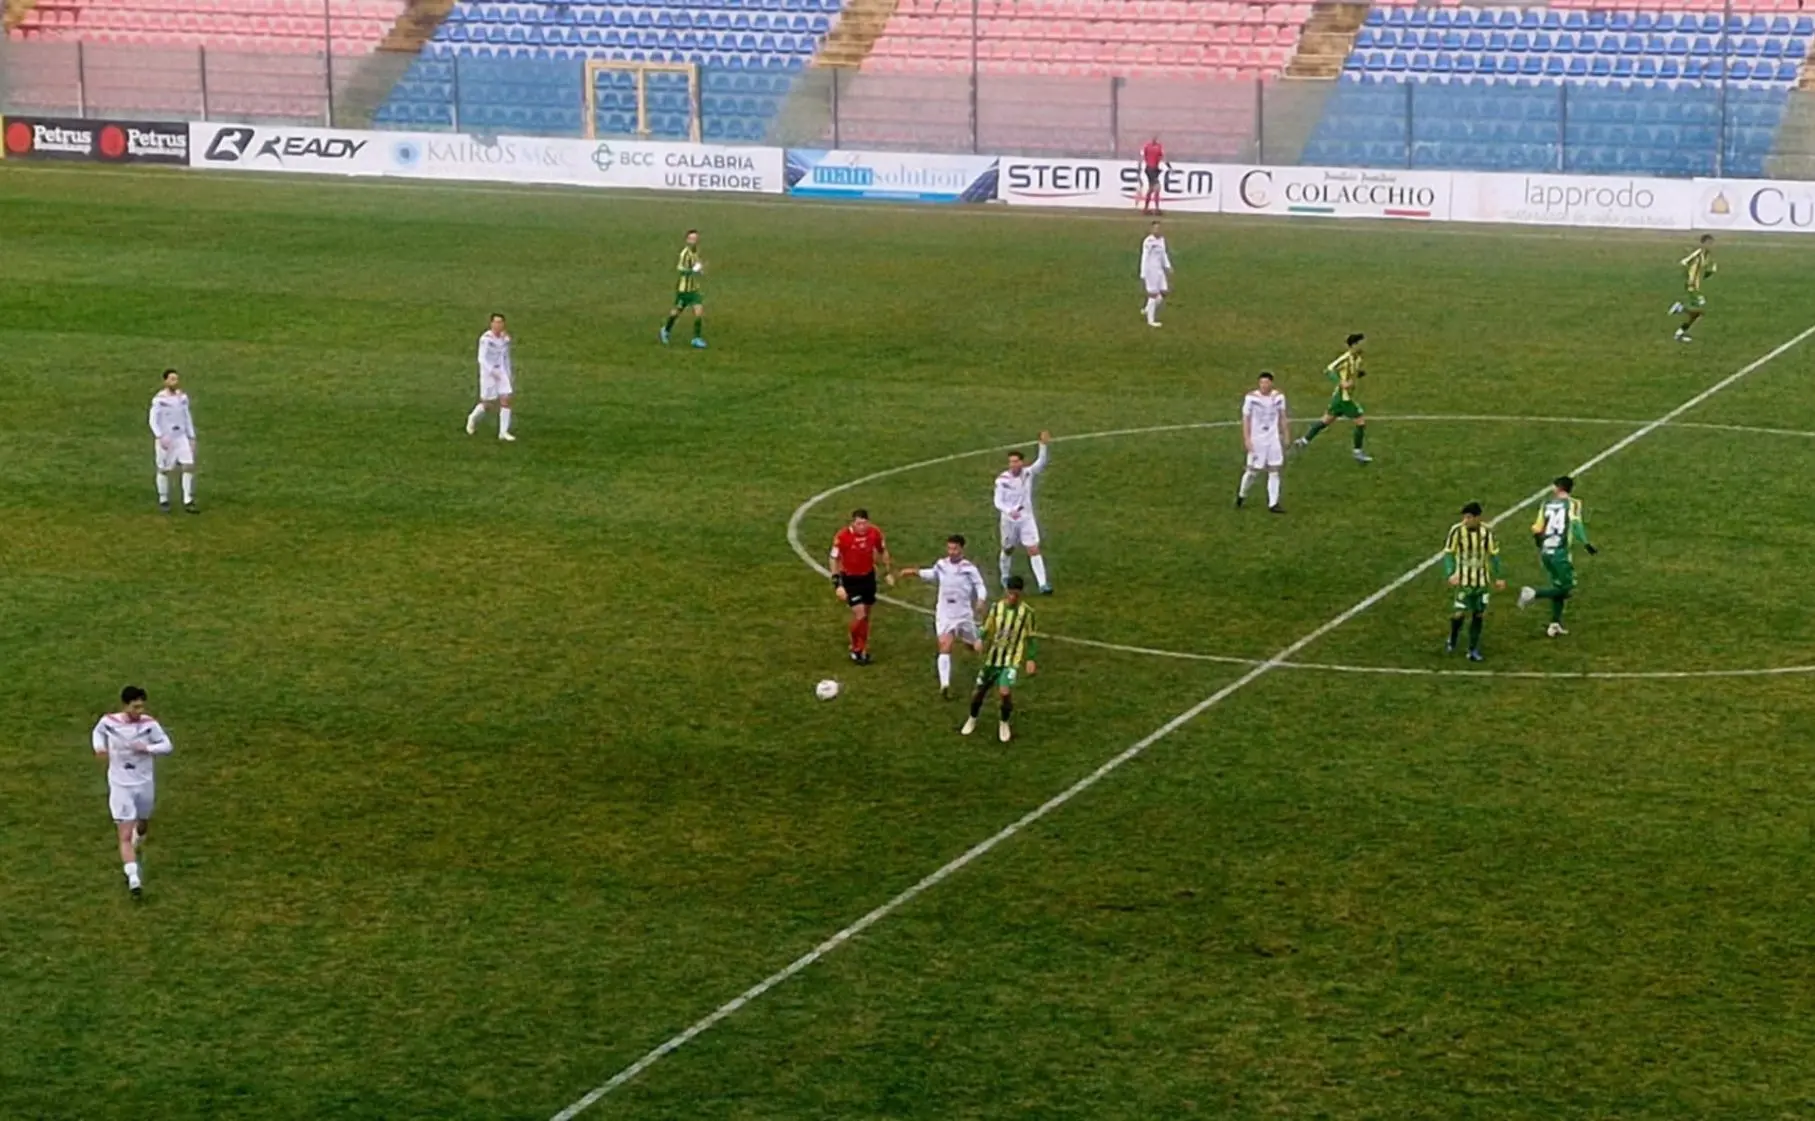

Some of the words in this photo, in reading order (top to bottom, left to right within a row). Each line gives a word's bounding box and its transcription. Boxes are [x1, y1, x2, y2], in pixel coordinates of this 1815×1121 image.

[33, 125, 92, 144] Petrus
[127, 129, 187, 147] Petrus
[428, 140, 517, 164] KAIROS
[620, 152, 654, 166] BCC
[665, 153, 755, 171] CALABRIA
[665, 173, 762, 190] ULTERIORE
[1009, 165, 1100, 189] STEM
[1120, 168, 1213, 194] SEM
[1285, 183, 1435, 207] COLACCHIO
[1525, 177, 1655, 213] lapprodo
